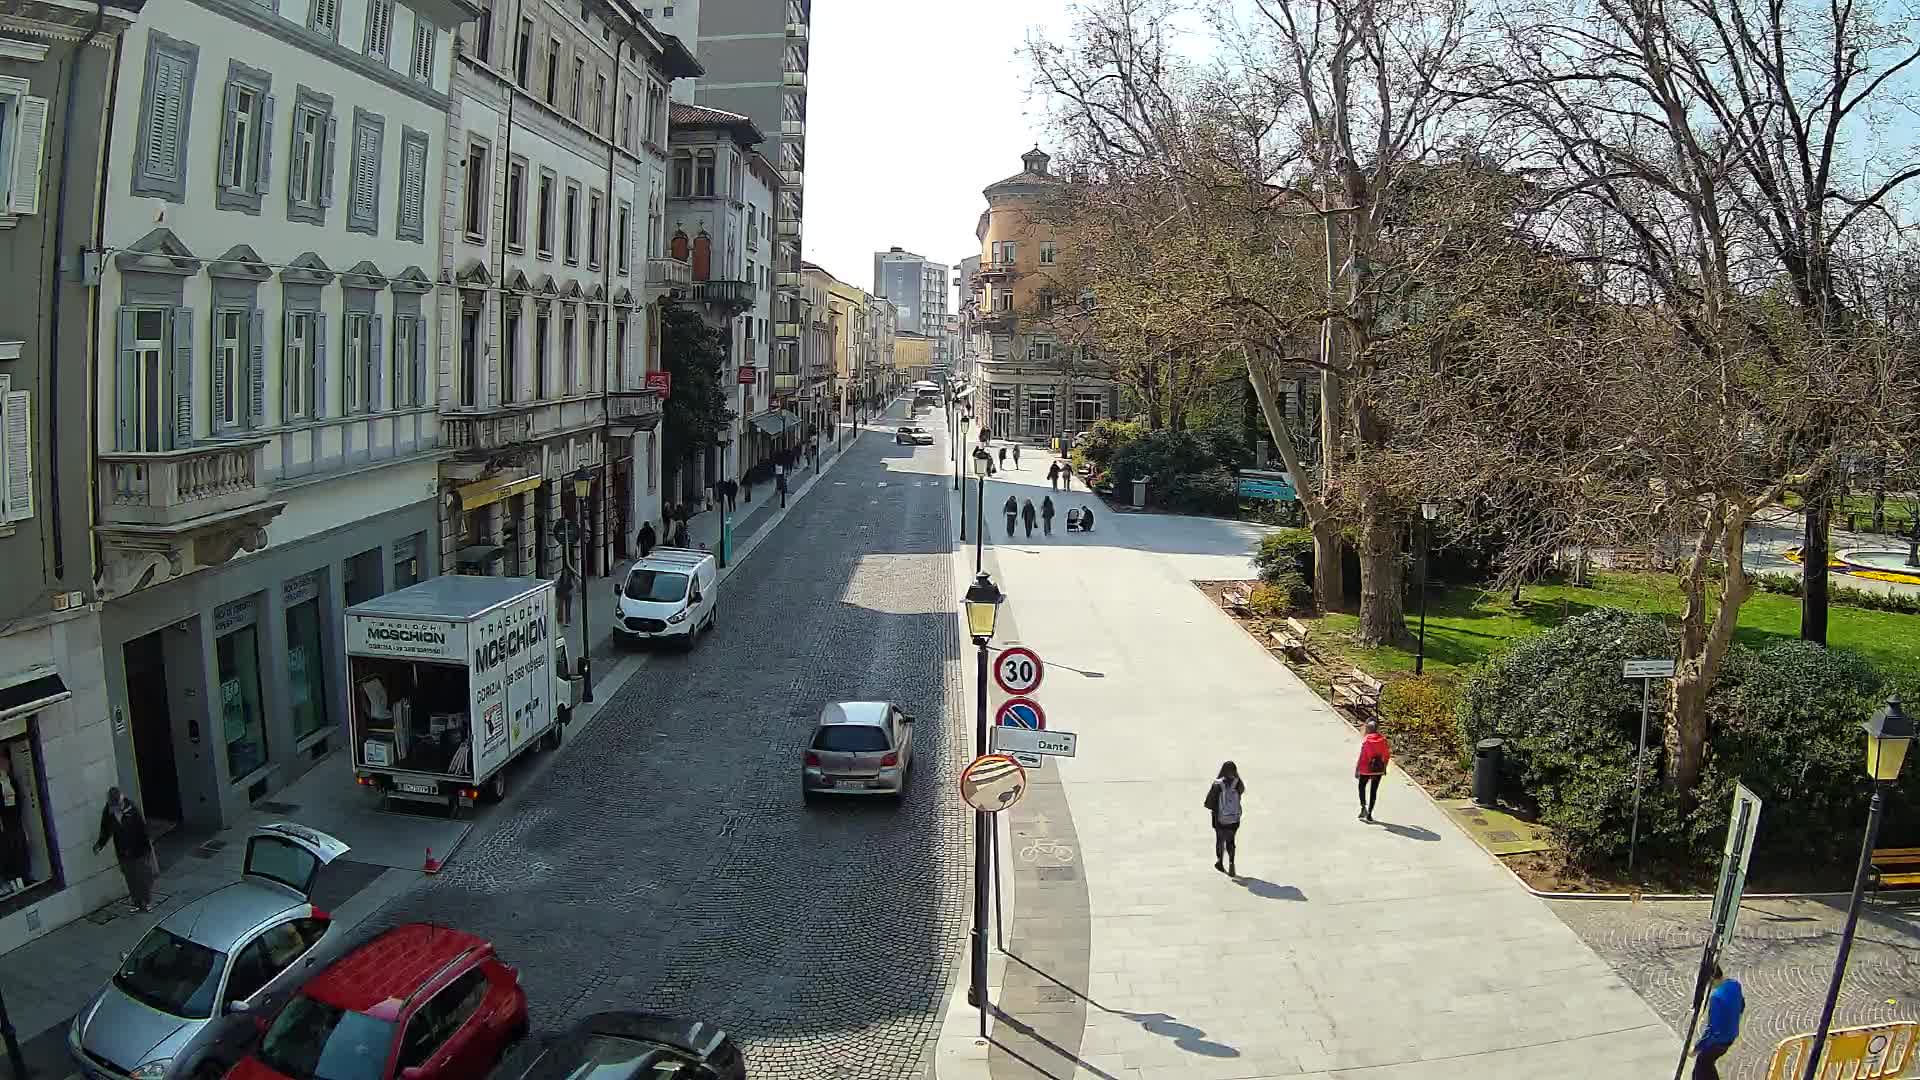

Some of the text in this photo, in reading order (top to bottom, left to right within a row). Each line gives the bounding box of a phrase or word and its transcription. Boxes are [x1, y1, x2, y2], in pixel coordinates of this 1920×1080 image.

[480, 600, 544, 640] TRASLOCHI
[367, 628, 446, 645] MOSCHION
[475, 615, 547, 674] MOSCHION
[1005, 660, 1033, 683] 30
[1038, 740, 1070, 753] Dante
